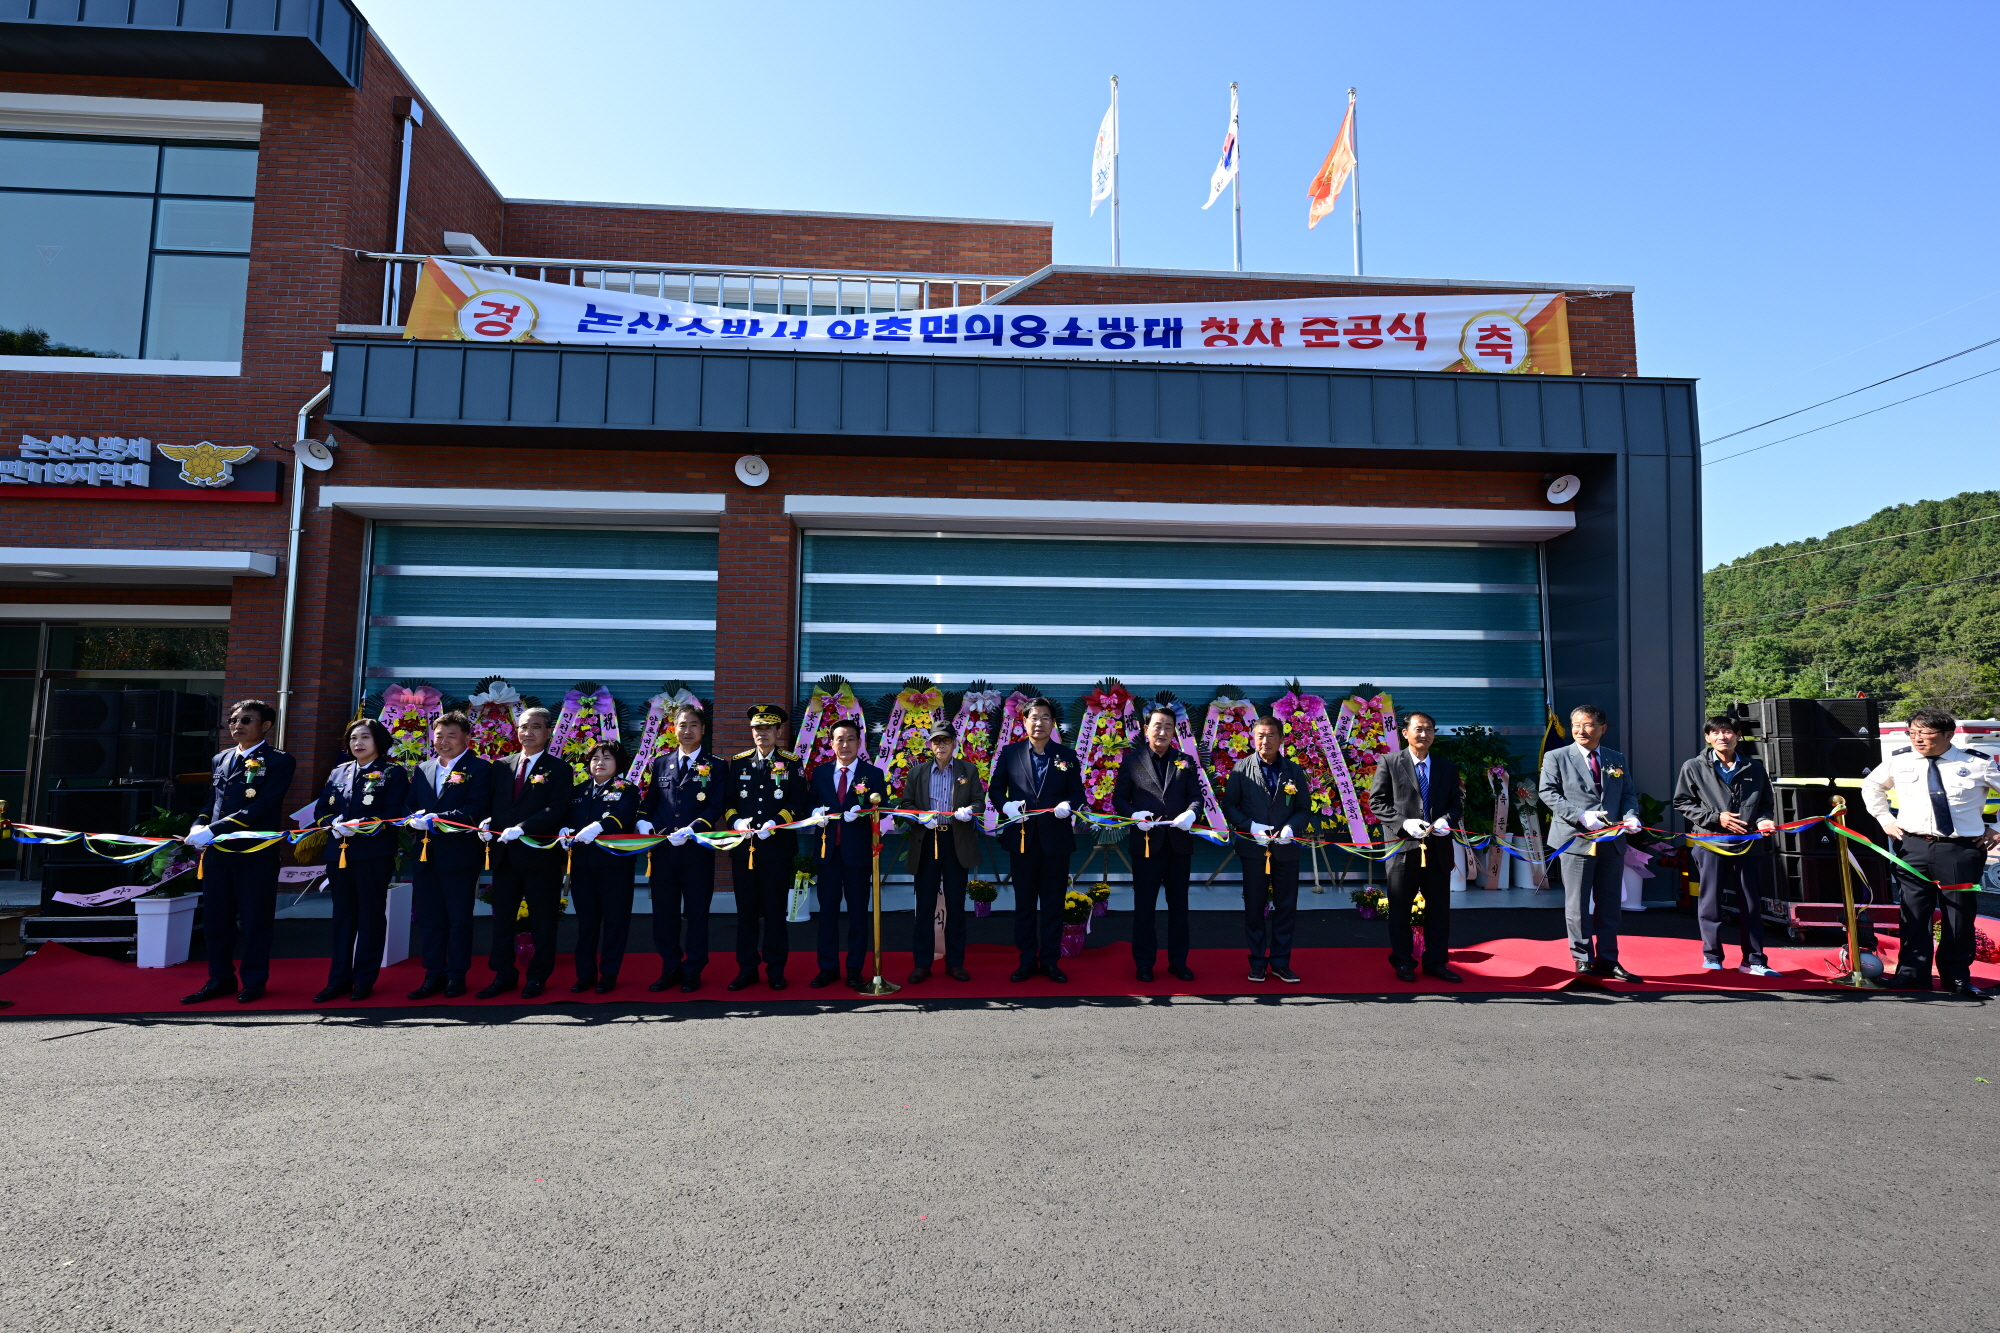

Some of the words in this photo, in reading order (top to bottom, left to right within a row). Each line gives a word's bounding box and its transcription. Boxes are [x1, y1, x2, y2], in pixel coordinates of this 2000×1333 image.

[473, 301, 520, 337] 경
[1200, 316, 1285, 348] 청사
[1299, 312, 1428, 351] 준공식
[1475, 324, 1513, 364] 축
[19, 435, 151, 463] 논산소방서
